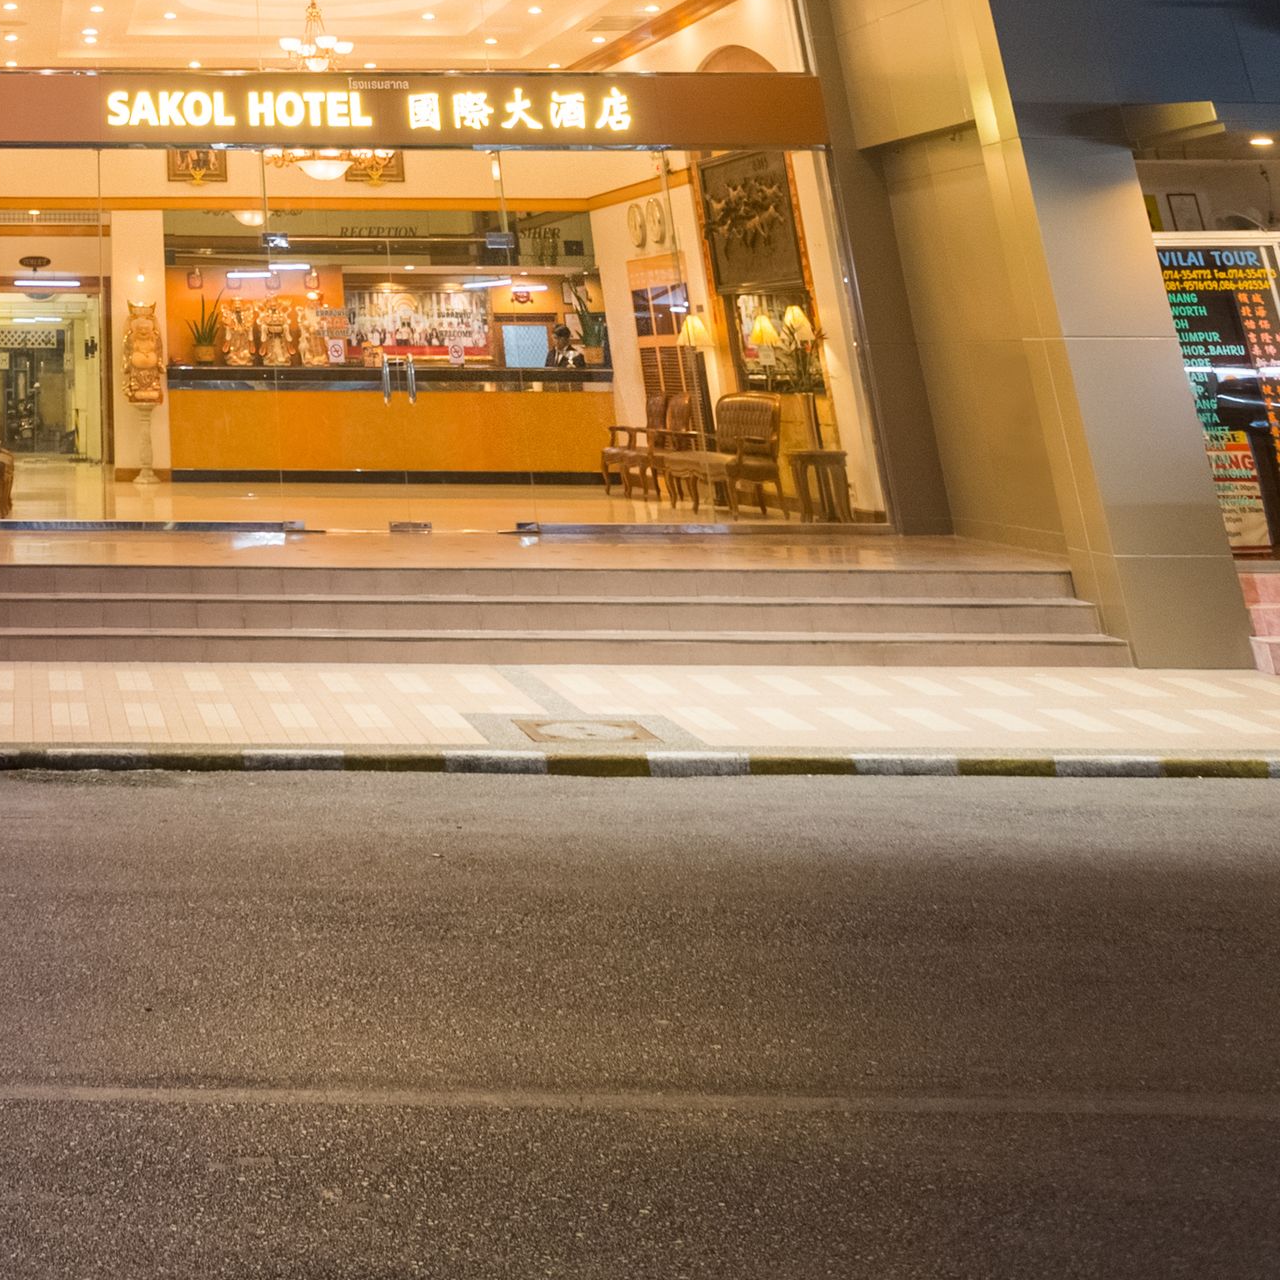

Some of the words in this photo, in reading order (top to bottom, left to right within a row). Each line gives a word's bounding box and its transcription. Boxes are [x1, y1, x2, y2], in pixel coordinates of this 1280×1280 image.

[348, 77, 410, 90] โรงแรมสากล
[106, 91, 236, 128] SAKOL
[247, 91, 373, 128] HOTEL
[407, 86, 633, 132] 國際大酒店
[340, 225, 418, 238] RECEPTION
[1158, 251, 1205, 266] VILAI
[1210, 251, 1260, 266] TOUR
[1214, 268, 1277, 279] Fax.074-35473
